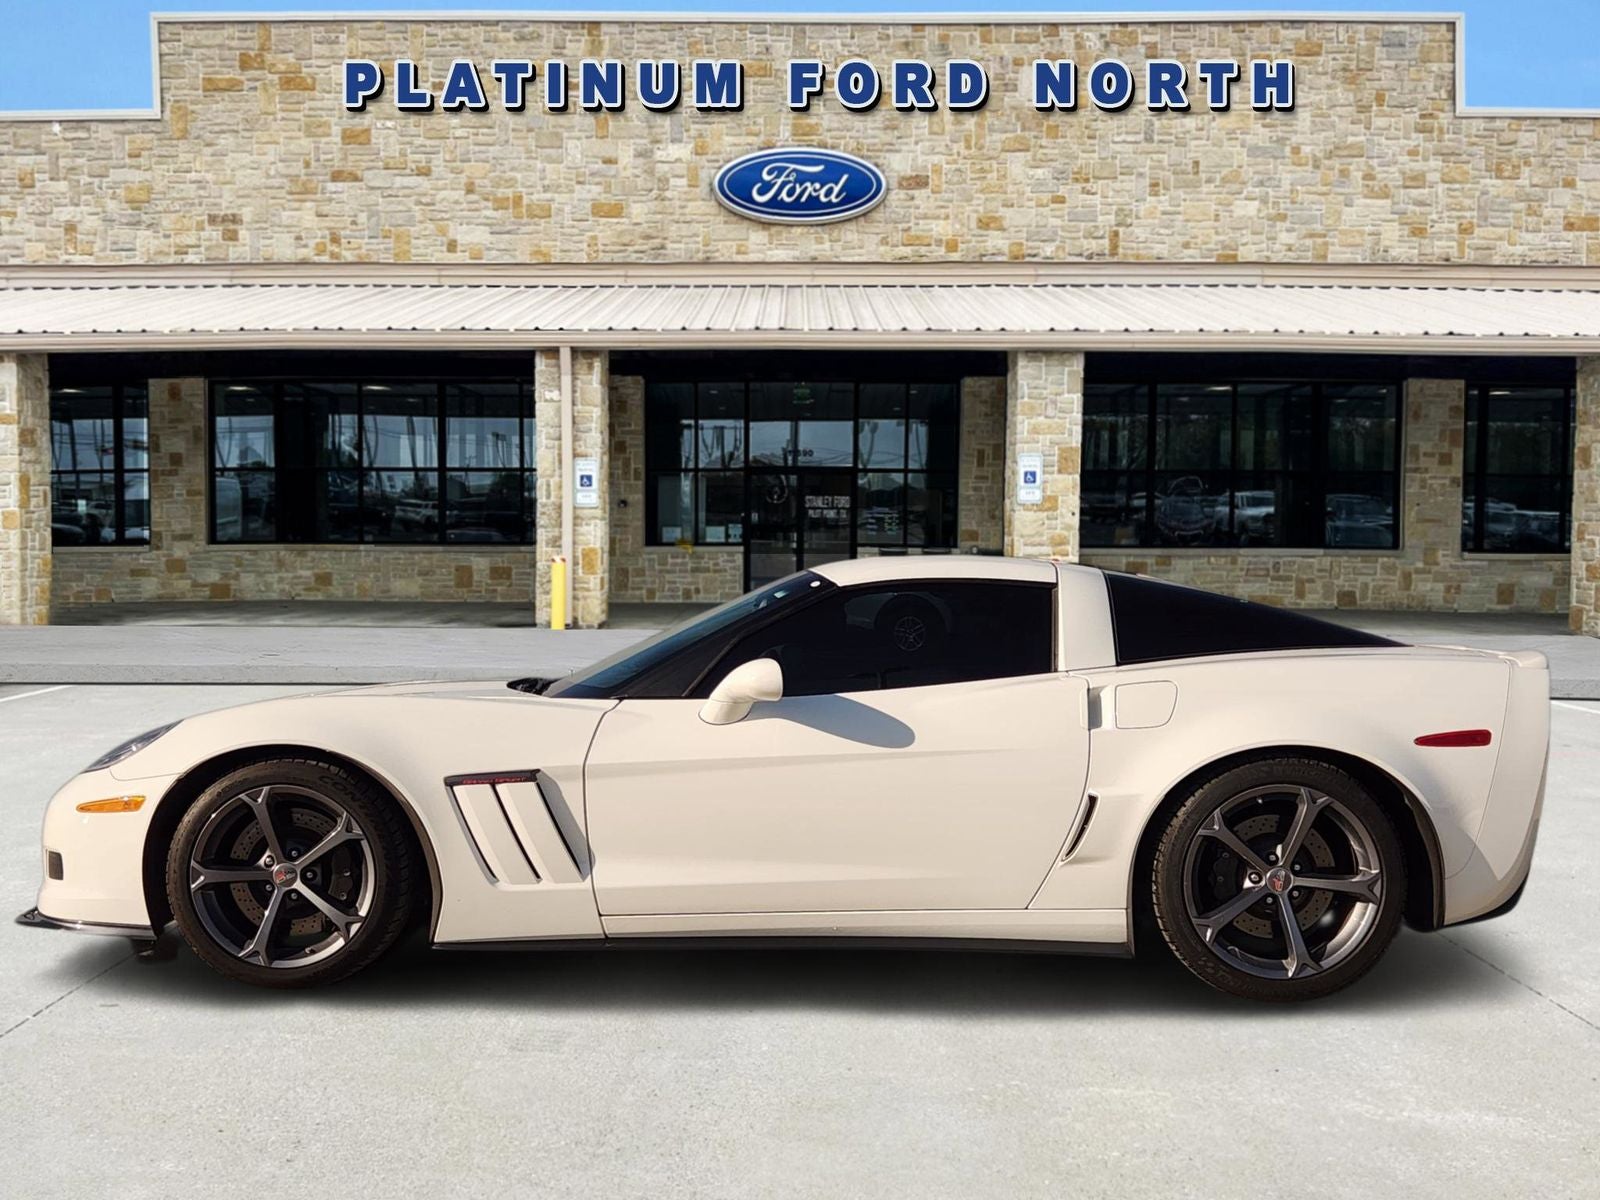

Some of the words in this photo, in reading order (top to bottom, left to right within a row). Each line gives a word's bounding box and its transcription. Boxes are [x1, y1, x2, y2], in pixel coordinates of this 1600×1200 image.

[343, 58, 743, 110] PLATINUM
[788, 58, 988, 110] FORD
[1033, 58, 1296, 110] NORTH
[751, 162, 848, 204] Ford
